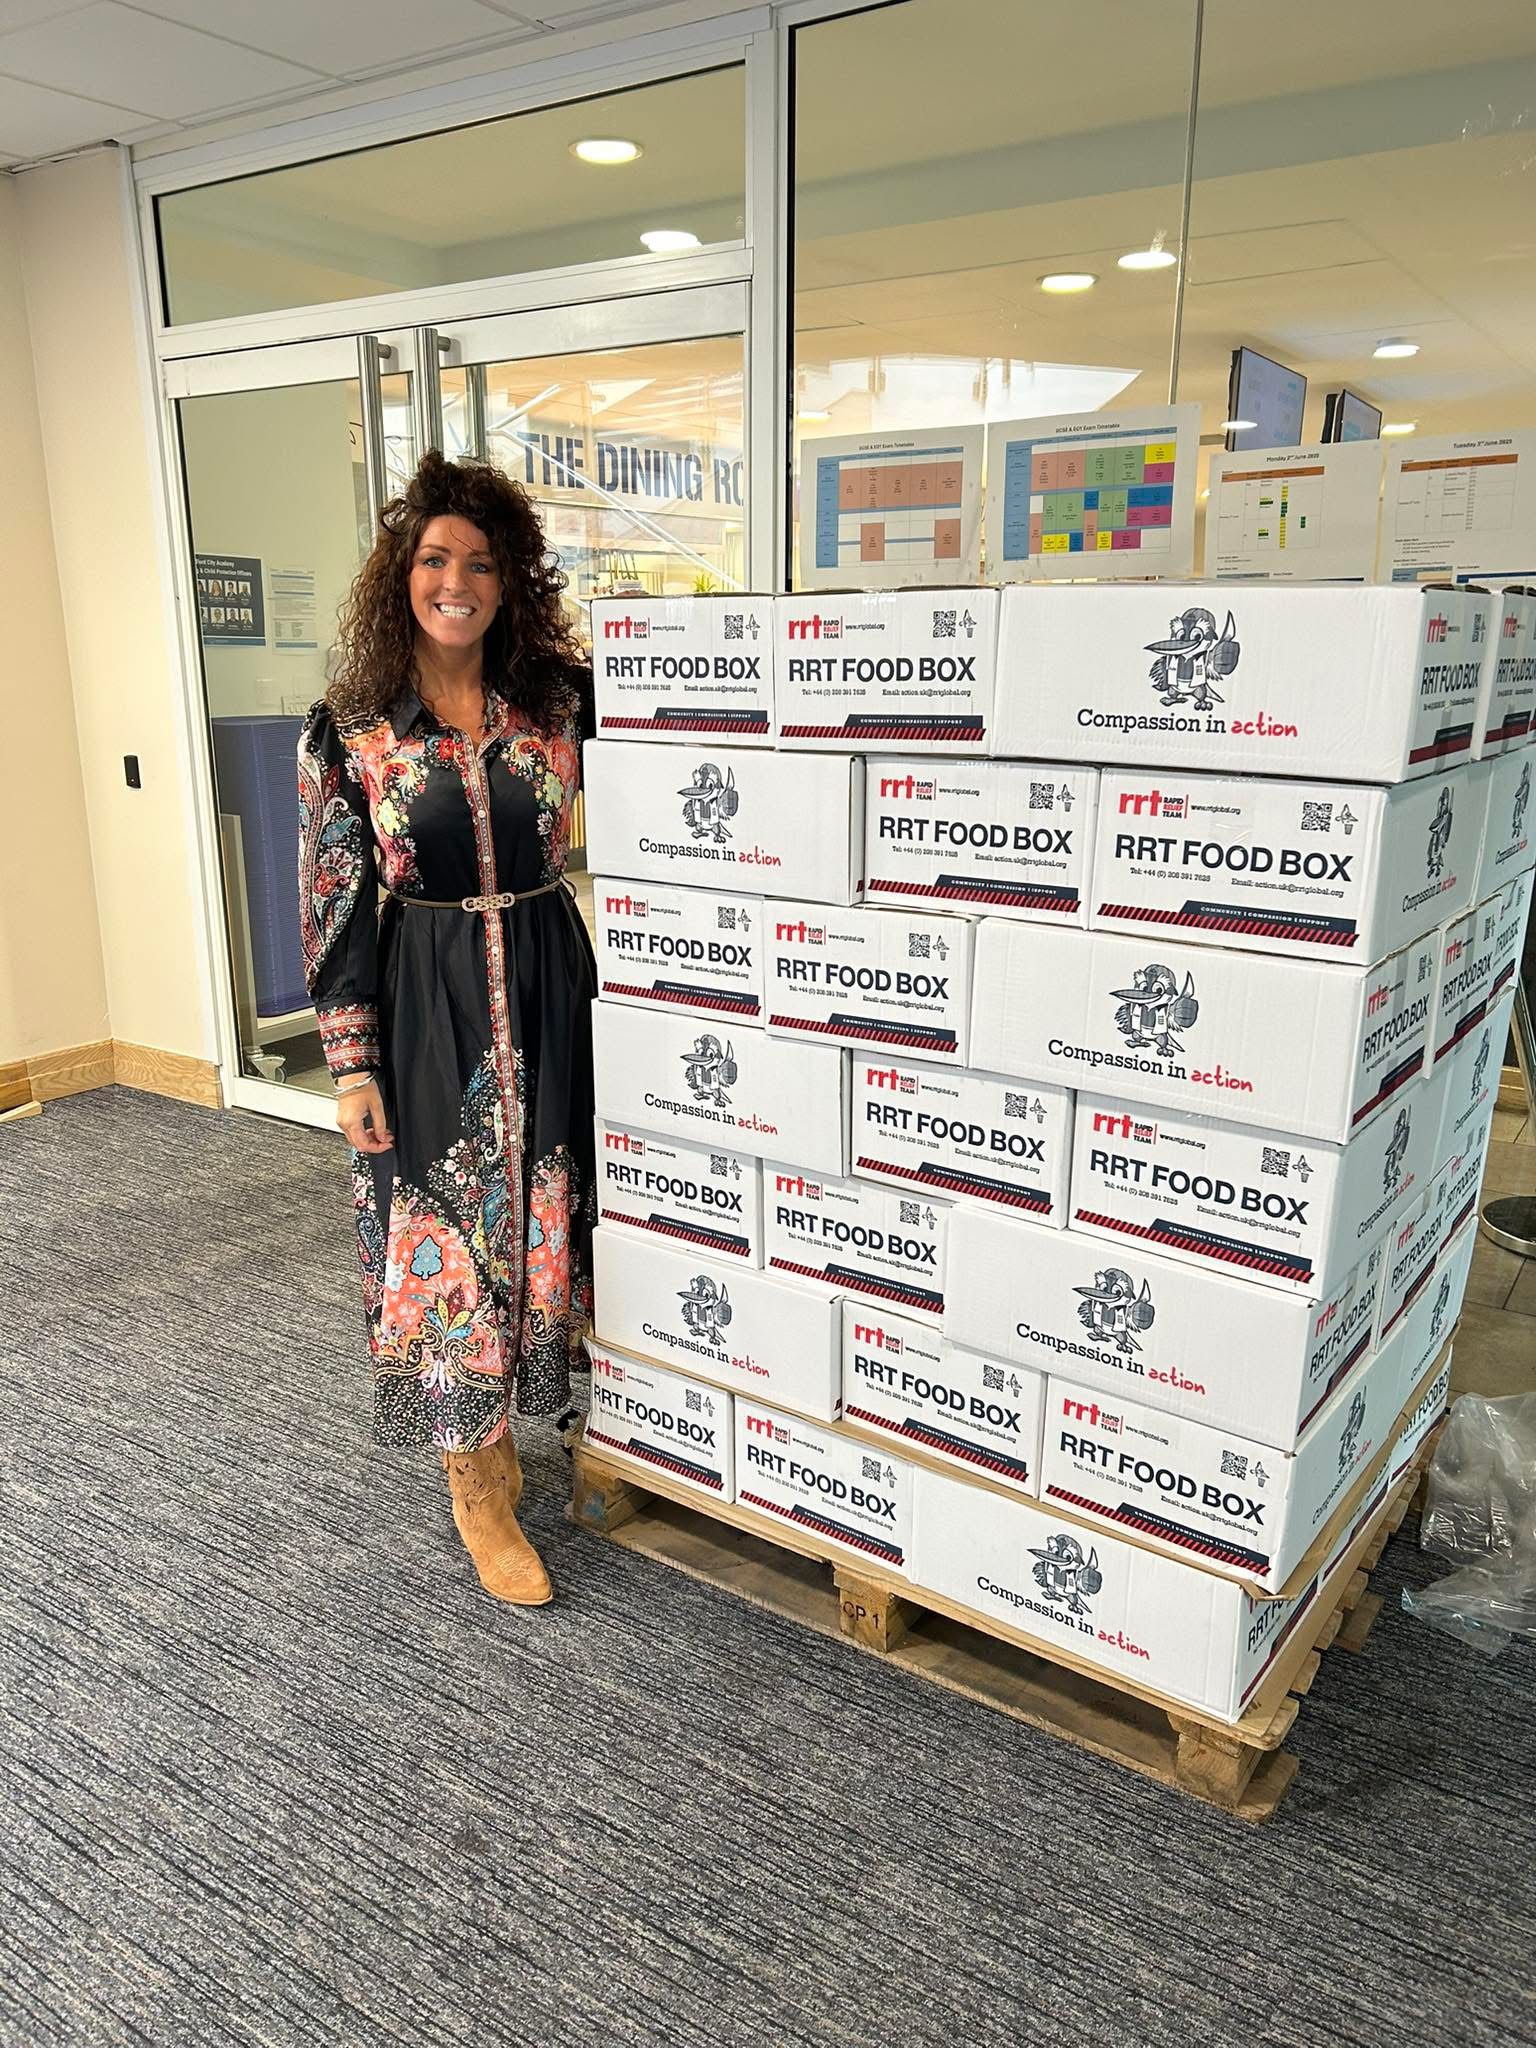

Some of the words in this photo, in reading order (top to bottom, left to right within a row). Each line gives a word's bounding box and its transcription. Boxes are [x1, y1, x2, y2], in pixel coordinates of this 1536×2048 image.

[517, 432, 584, 489] THE
[597, 442, 702, 501] DINING
[605, 616, 633, 638] rrt
[789, 615, 822, 640] rrt
[606, 656, 646, 677] RRT
[651, 657, 709, 679] FOOD
[714, 657, 761, 679] BOX
[789, 659, 837, 681] RRT
[843, 658, 913, 682] FOOD
[919, 657, 976, 682] BOX
[1421, 666, 1441, 695] RRT
[1440, 664, 1463, 693] FOOD
[1462, 663, 1480, 689] BOX
[1078, 709, 1201, 733] Compassion
[1206, 714, 1226, 733] in
[1231, 712, 1297, 737] action
[880, 775, 915, 799] rrt
[1119, 790, 1162, 816] rrt
[880, 816, 929, 841] RRT
[934, 820, 1008, 847] FOOD
[1014, 826, 1073, 854] BOX
[639, 838, 719, 859] Compassion
[722, 846, 736, 861] in
[739, 846, 781, 866] action
[1115, 834, 1177, 862] RRT
[1182, 840, 1272, 872] FOOD
[1279, 850, 1353, 882] BOX
[606, 895, 632, 915] rrt
[776, 921, 807, 943] rrt
[607, 929, 645, 951] RRT
[649, 934, 704, 959] FOOD
[708, 942, 752, 967] BOX
[777, 957, 821, 982] RRT
[826, 963, 891, 991] FOOD
[897, 972, 949, 999] BOX
[1362, 1026, 1383, 1063] RRT
[1383, 1008, 1409, 1048] FOOD
[1409, 994, 1430, 1027] BOX
[867, 1069, 899, 1090] rrt
[1049, 1039, 1163, 1075] Compassion
[1167, 1061, 1186, 1079] in
[1191, 1065, 1252, 1091] action
[645, 1093, 720, 1121] Compassion
[723, 1110, 735, 1125] in
[738, 1114, 777, 1135] action
[1093, 1113, 1133, 1138] rrt
[1134, 1123, 1153, 1132] RAPID
[606, 1133, 630, 1152] rrt
[867, 1101, 912, 1129] RRT
[917, 1113, 985, 1146] FOOD
[990, 1129, 1045, 1162] BOX
[1133, 1135, 1151, 1144] TEAM
[607, 1162, 641, 1185] RRT
[646, 1171, 697, 1199] FOOD
[701, 1185, 742, 1212] BOX
[777, 1176, 805, 1196] rrt
[1090, 1149, 1147, 1182] RRT
[1152, 1165, 1235, 1204] FOOD
[1241, 1187, 1309, 1225] BOX
[777, 1206, 818, 1232] RRT
[823, 1218, 883, 1249] FOOD
[888, 1234, 937, 1265] BOX
[643, 1323, 714, 1358] Compassion
[717, 1348, 729, 1363] in
[731, 1355, 769, 1378] action
[855, 1324, 885, 1348] rrt
[1017, 1323, 1123, 1368] Compassion
[1127, 1357, 1144, 1376] in
[1148, 1367, 1205, 1395] action
[1310, 1337, 1332, 1378] RRT
[855, 1355, 897, 1385] RRT
[902, 1372, 965, 1410] FOOD
[970, 1396, 1020, 1433] BOX
[626, 1397, 673, 1429] FOOD
[678, 1417, 716, 1448] BOX
[747, 1416, 774, 1438] rrt
[1063, 1399, 1100, 1426] rrt
[1102, 1412, 1119, 1422] RAPID
[1101, 1423, 1117, 1434] TEAM
[747, 1444, 785, 1473] RRT
[790, 1461, 846, 1498] FOOD
[851, 1486, 896, 1521] BOX
[1060, 1432, 1113, 1467] RRT
[1119, 1453, 1196, 1497] FOOD
[1202, 1483, 1265, 1525] BOX
[843, 1601, 866, 1621] CP
[873, 1614, 879, 1629] 1
[978, 1576, 1074, 1628] Compassion
[1078, 1618, 1094, 1636] in
[1098, 1630, 1149, 1659] action
[1248, 1605, 1271, 1652] RRT
